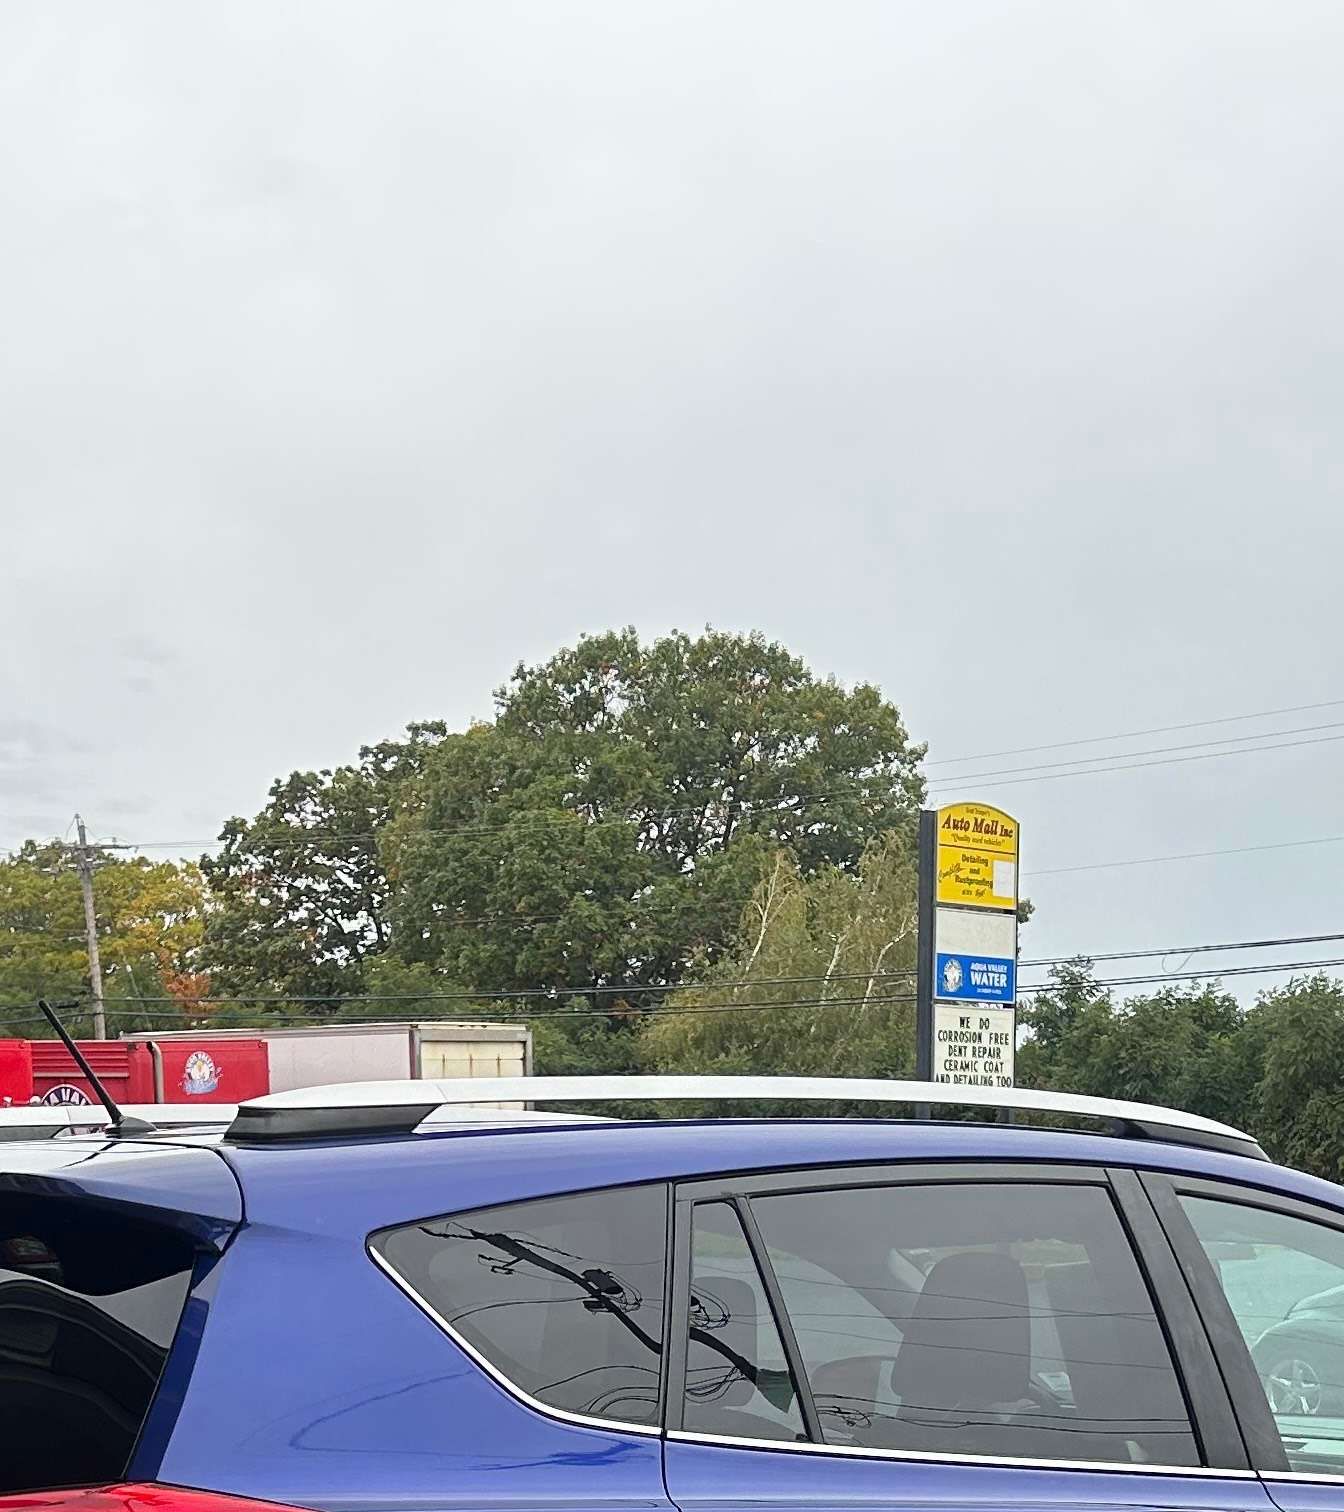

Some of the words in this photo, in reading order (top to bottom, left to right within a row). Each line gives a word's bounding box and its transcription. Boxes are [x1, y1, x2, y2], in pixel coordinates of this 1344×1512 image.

[942, 814, 970, 832] Auto
[972, 817, 998, 835] Mall
[999, 825, 1014, 838] Inc
[961, 854, 989, 867] Detailing
[970, 971, 1008, 987] WATER
[960, 1017, 970, 1029] WE
[979, 1018, 990, 1030] DO
[938, 1030, 982, 1043] CORROSION
[989, 1032, 1009, 1045] FREE
[948, 1045, 967, 1057] DENT
[972, 1046, 1001, 1059] REPAIR
[944, 1059, 978, 1072] CERAMIC
[984, 1061, 1004, 1073] COAT
[936, 1073, 950, 1083] AND
[953, 1074, 993, 1086] DETAILING
[997, 1076, 1012, 1088] TOO
